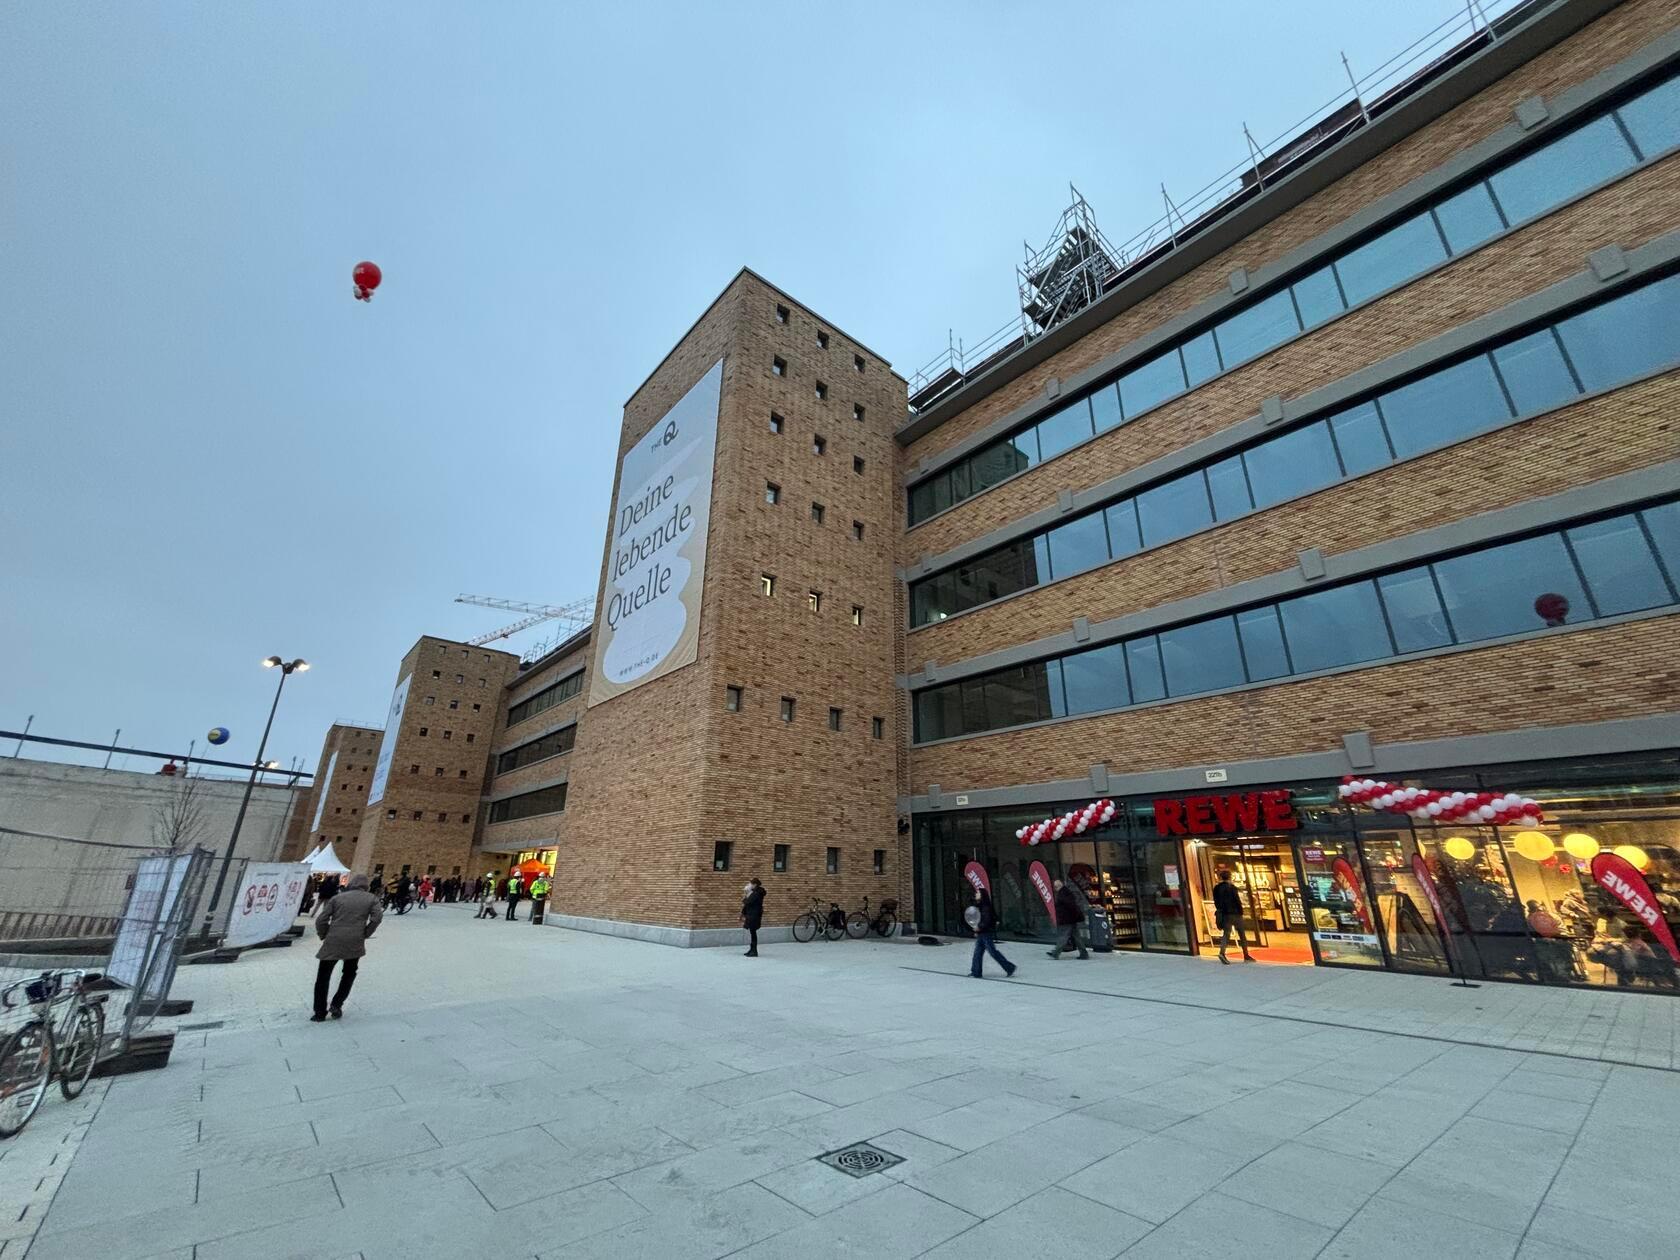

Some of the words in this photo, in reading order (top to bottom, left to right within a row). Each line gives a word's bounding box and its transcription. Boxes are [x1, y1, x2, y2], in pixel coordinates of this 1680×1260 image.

[663, 420, 679, 446] Q
[619, 475, 674, 538] Deine
[612, 503, 691, 583] lebende
[607, 563, 671, 632] Quelle
[1153, 788, 1297, 836] REWE
